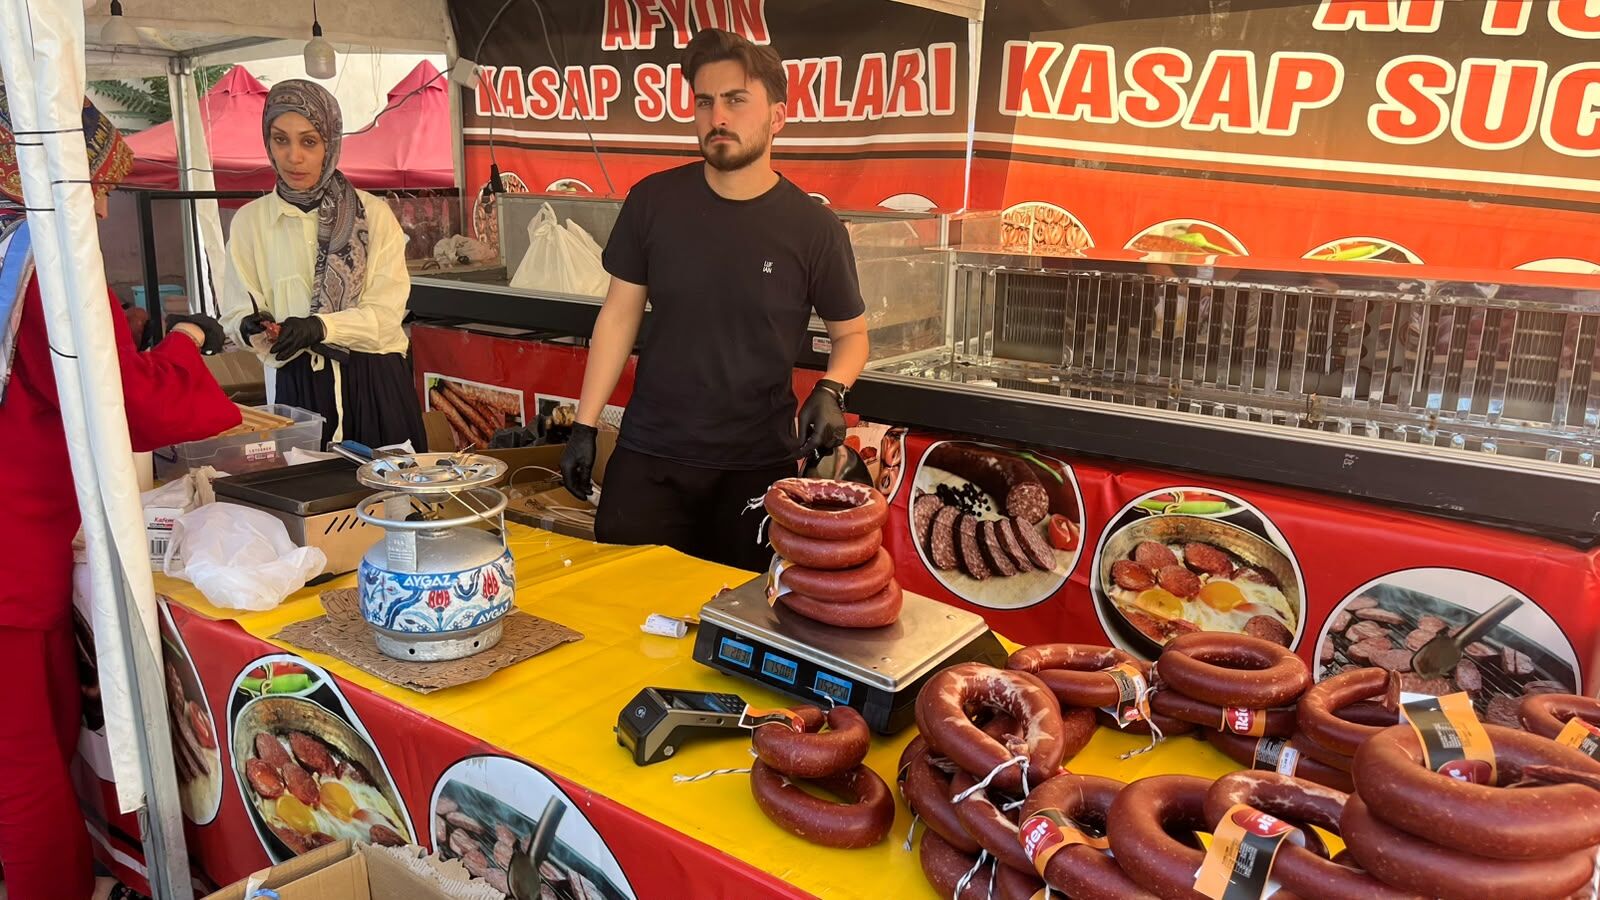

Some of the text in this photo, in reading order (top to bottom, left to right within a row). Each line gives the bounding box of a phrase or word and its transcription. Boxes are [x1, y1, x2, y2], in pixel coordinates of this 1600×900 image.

[601, 0, 771, 50] AFYON
[474, 42, 957, 123] KASAP SUKLARI
[999, 40, 1344, 137] KASAP
[403, 574, 451, 588] AYGAZ
[476, 601, 511, 625] AYGAZ
